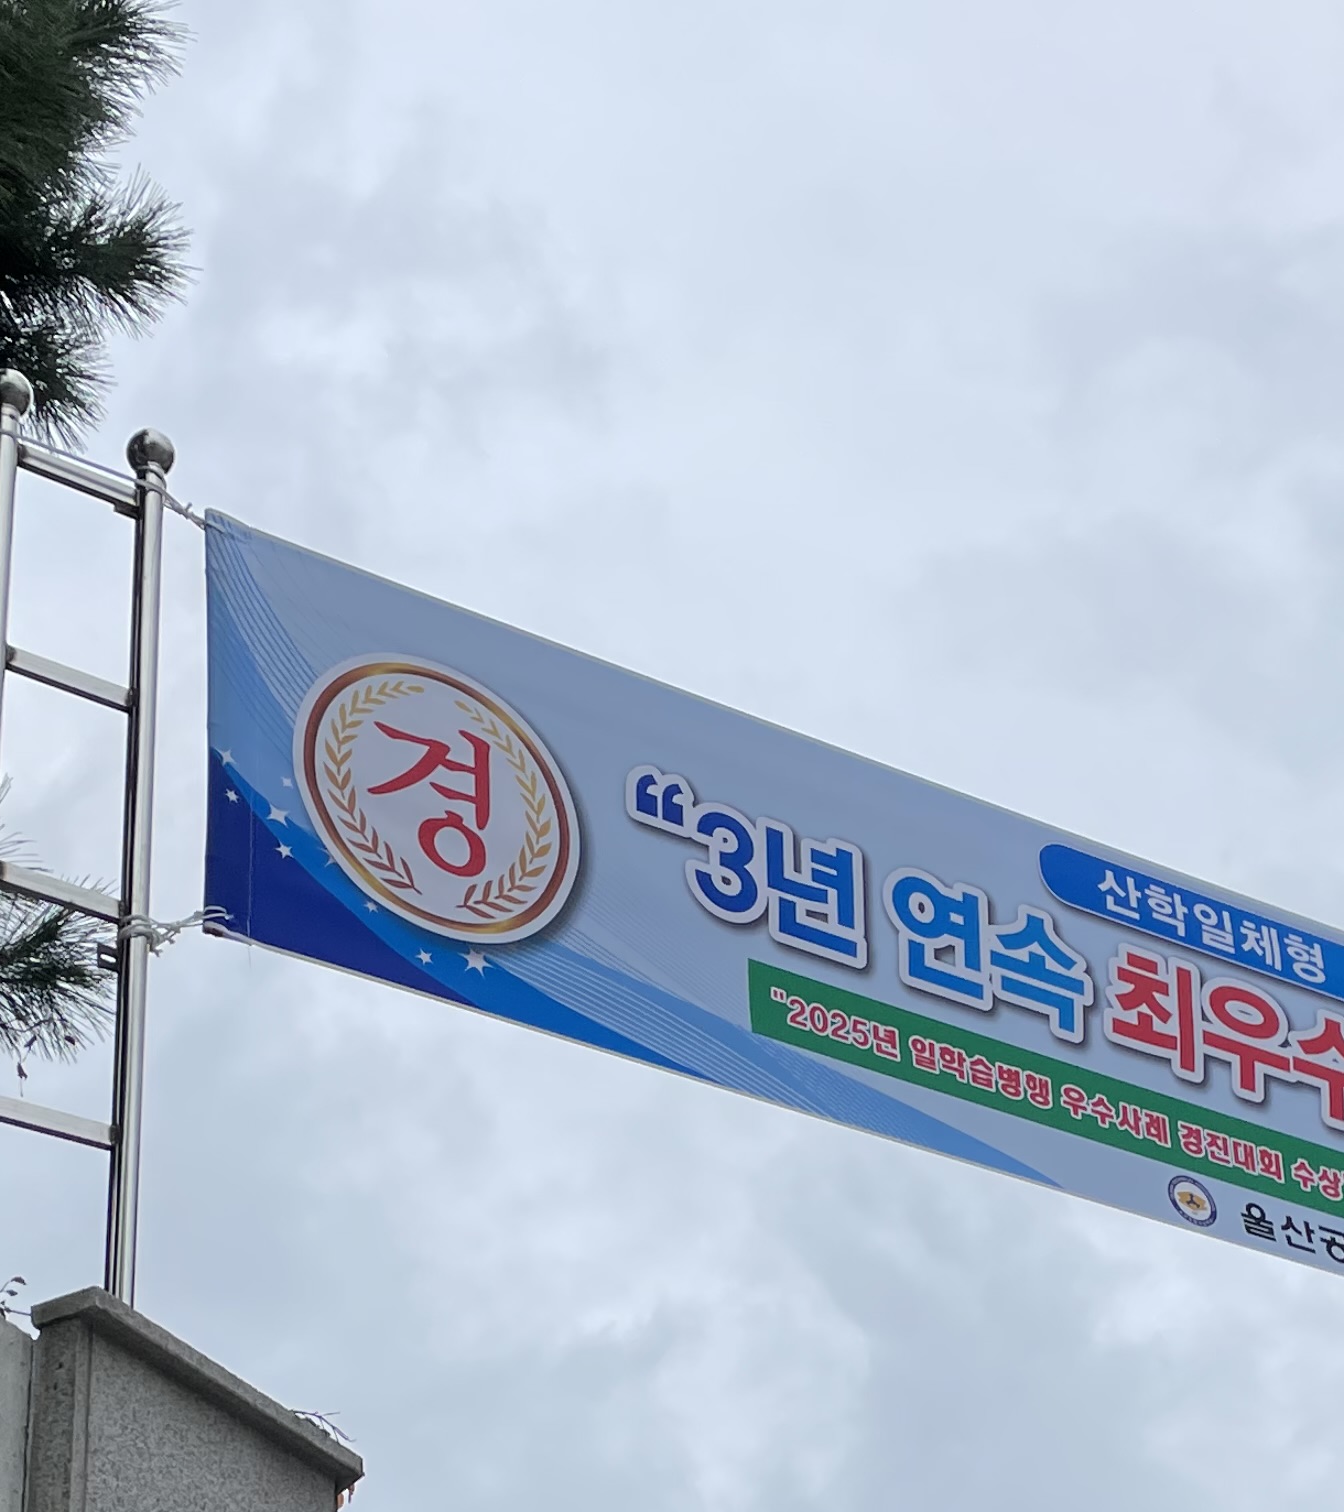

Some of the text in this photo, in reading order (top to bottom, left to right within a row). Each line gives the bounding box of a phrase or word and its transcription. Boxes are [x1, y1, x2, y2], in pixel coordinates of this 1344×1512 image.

[367, 720, 492, 879] 경
[892, 874, 1087, 1036] 연속
[1097, 869, 1327, 984] 산학일체형
[771, 987, 900, 1061] "2025년
[909, 1036, 1052, 1108] 일학습병행
[1061, 1084, 1171, 1147] 우수사례
[1178, 1121, 1286, 1183] 경진대회
